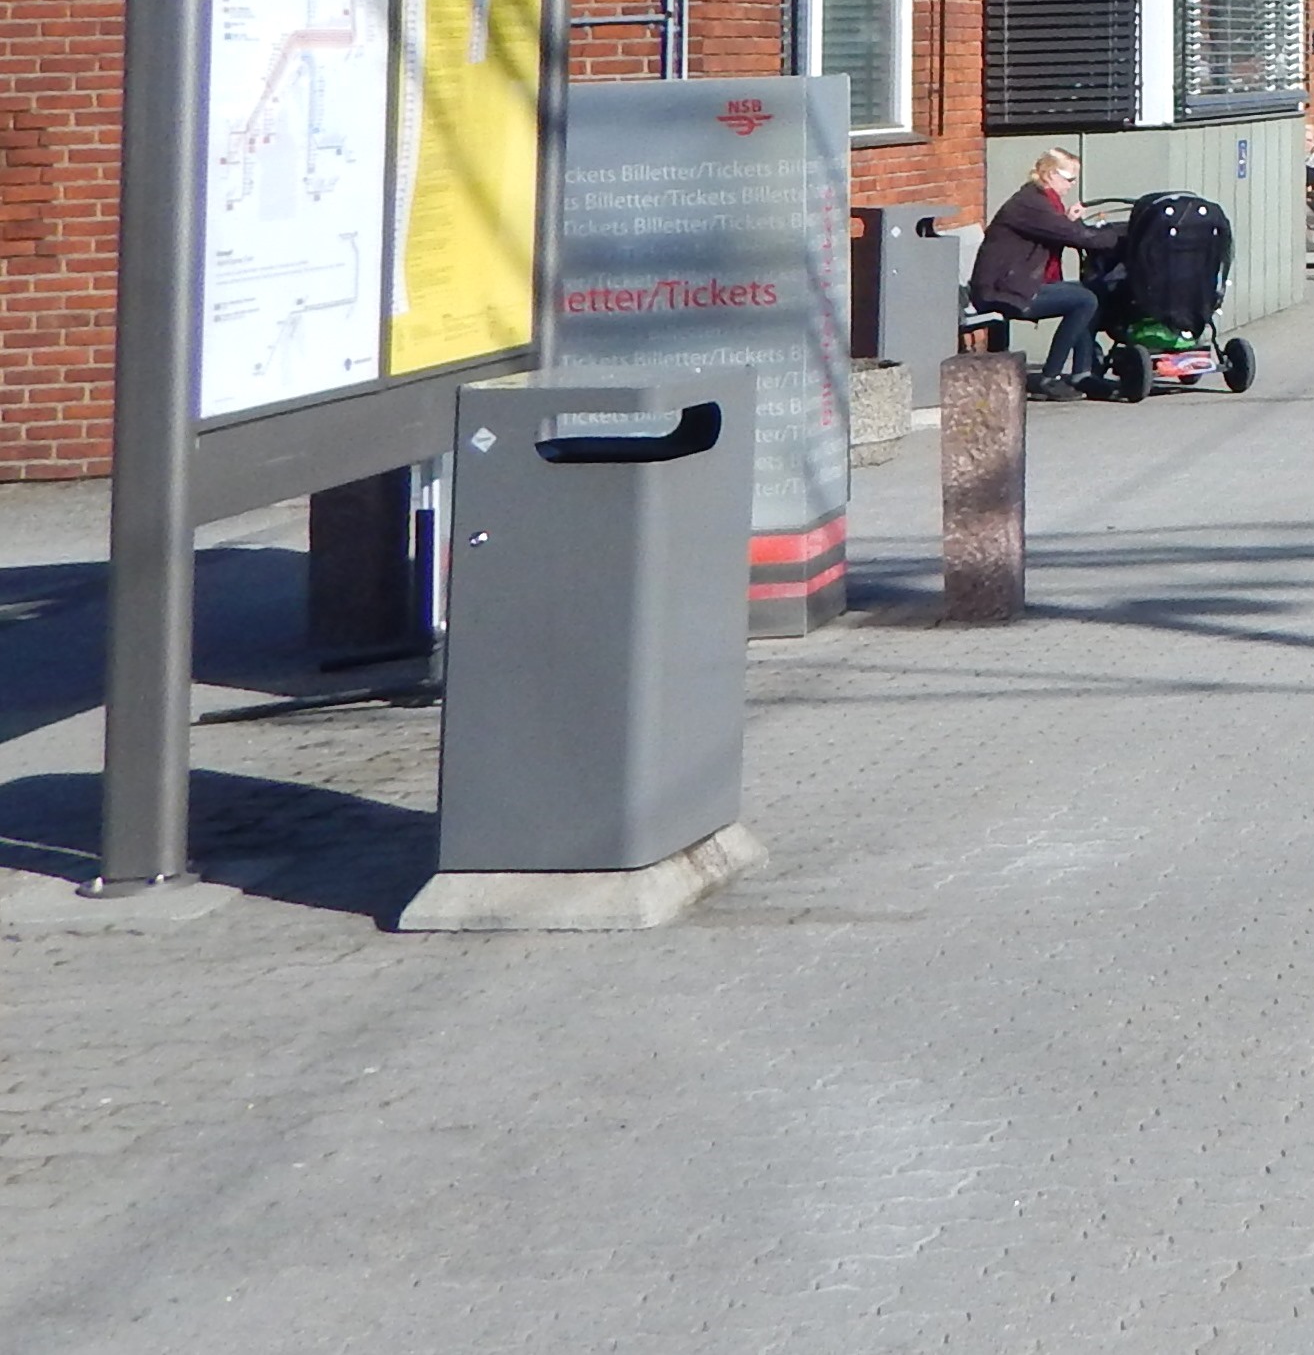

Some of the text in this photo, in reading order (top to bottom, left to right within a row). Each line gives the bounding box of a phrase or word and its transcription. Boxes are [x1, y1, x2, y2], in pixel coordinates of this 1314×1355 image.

[728, 99, 762, 114] NSB
[621, 160, 773, 182] Billetter/Tickets
[585, 186, 736, 210] Billetter/Tickets
